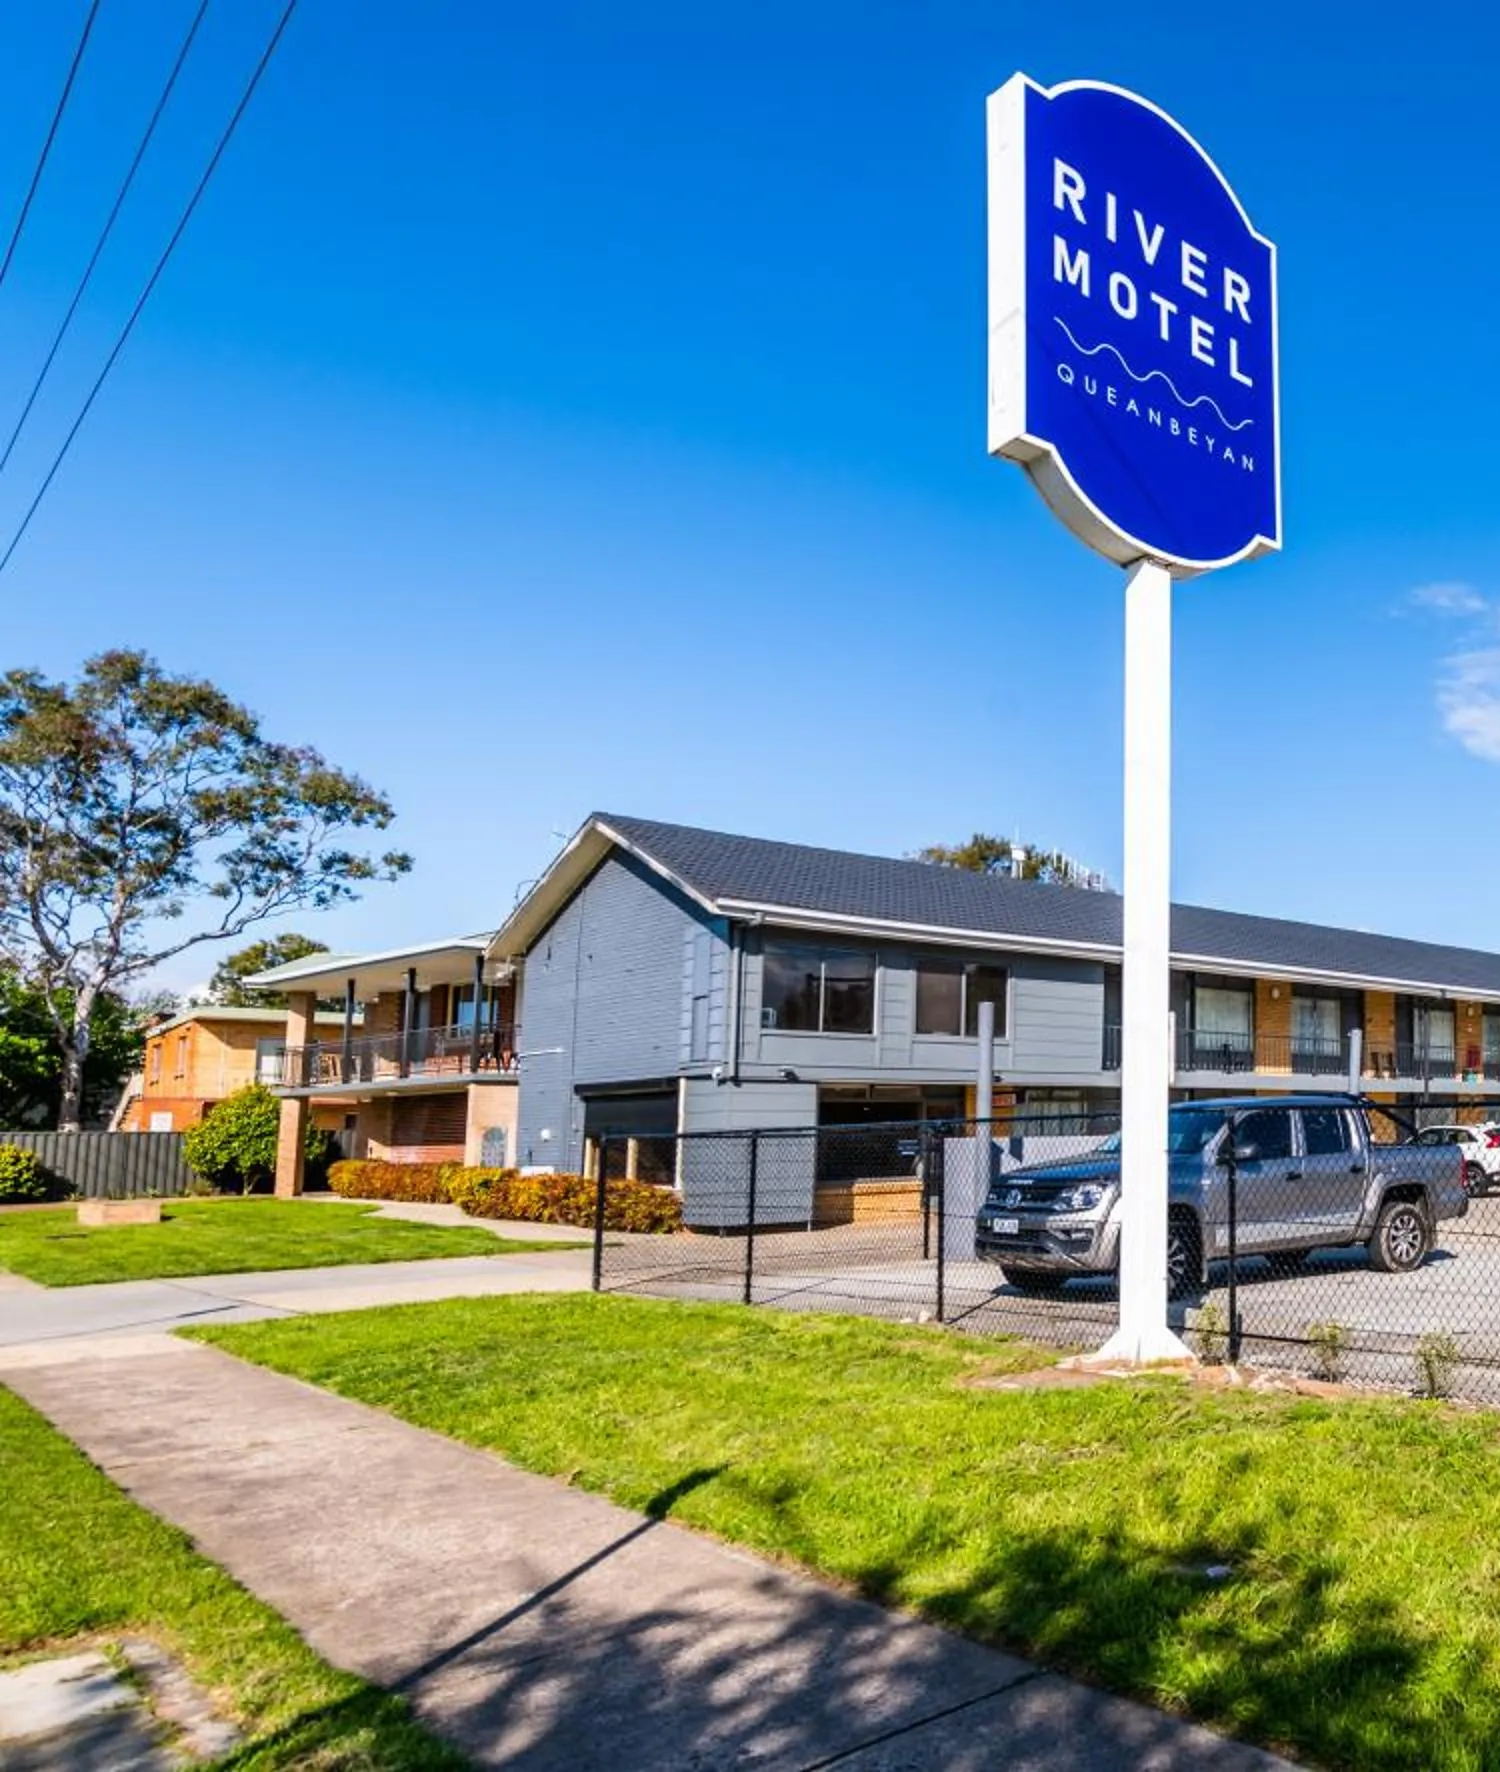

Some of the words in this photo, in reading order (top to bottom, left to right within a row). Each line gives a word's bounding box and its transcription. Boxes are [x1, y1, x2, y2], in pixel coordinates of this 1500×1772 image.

[1053, 157, 1253, 325] RIVER
[1053, 234, 1253, 388] MOTEL
[1056, 362, 1254, 473] QUEANBEYAN
